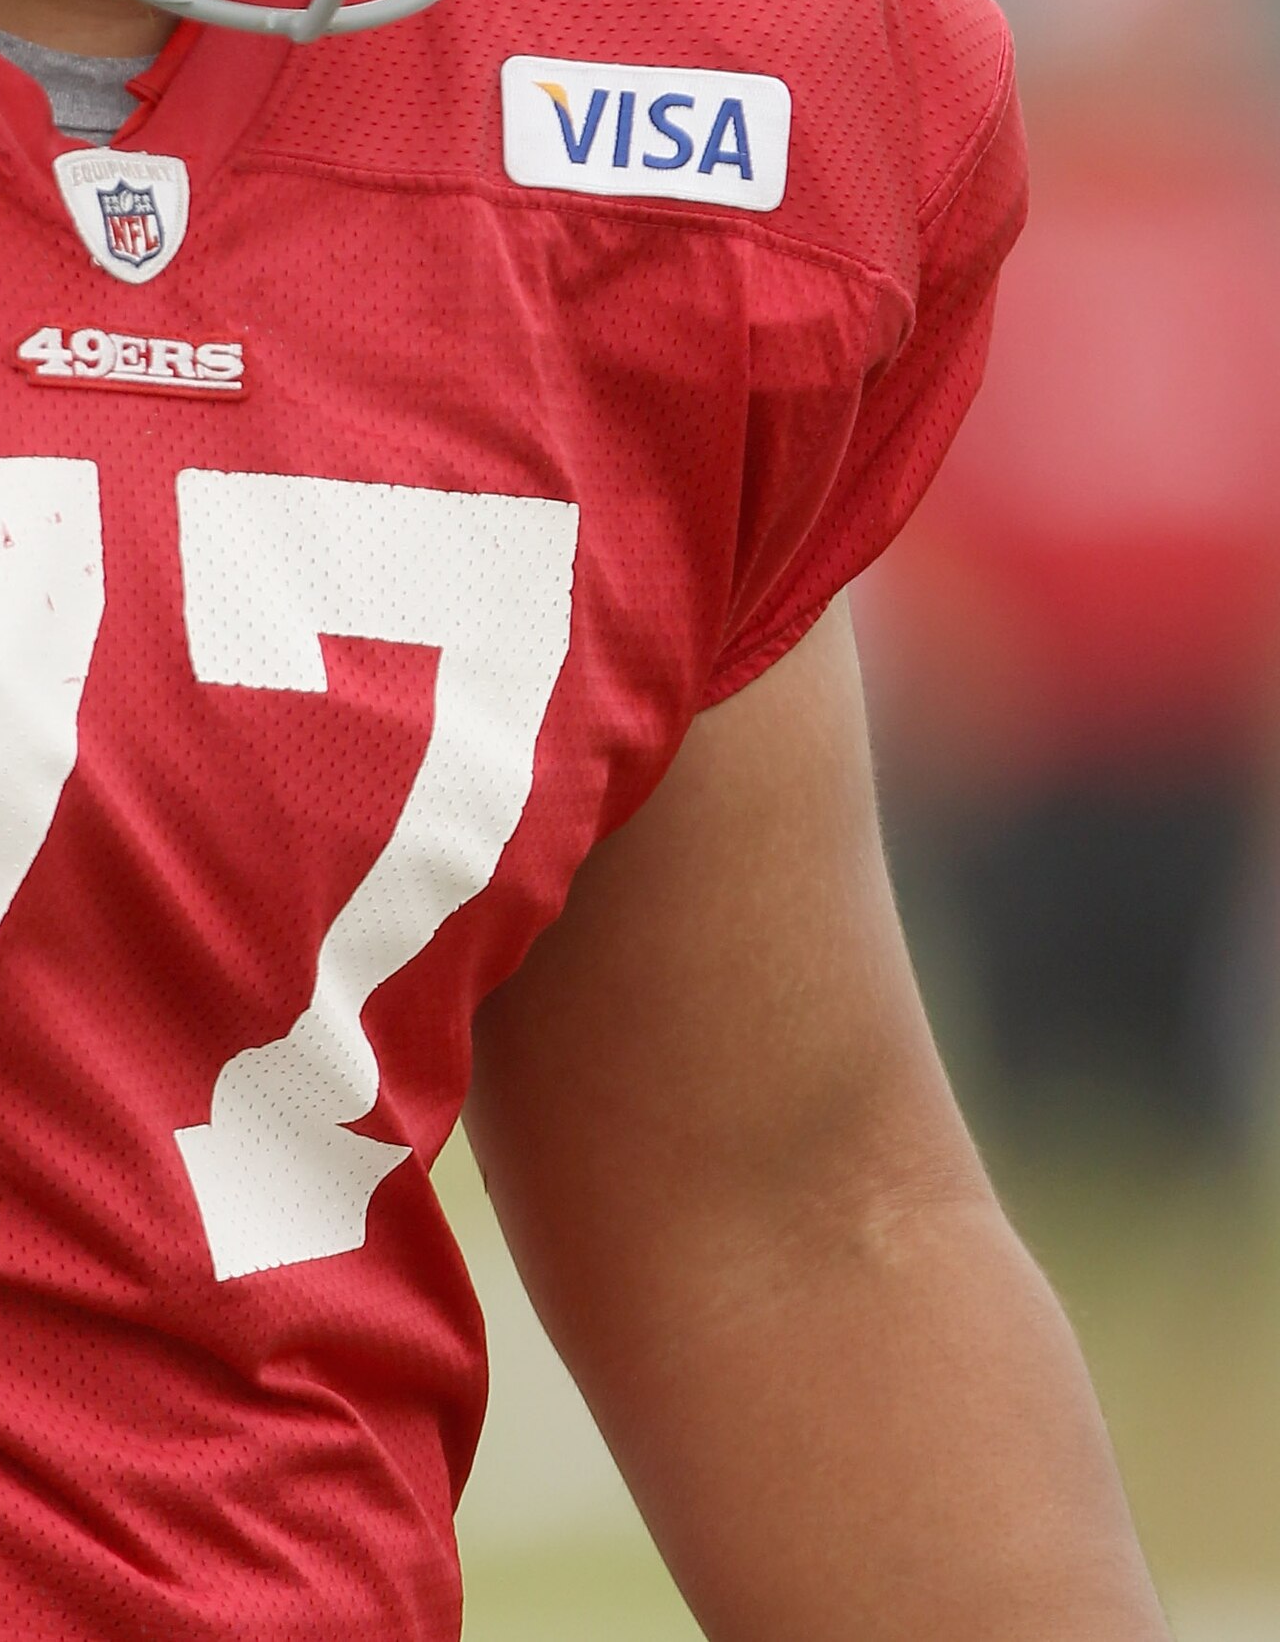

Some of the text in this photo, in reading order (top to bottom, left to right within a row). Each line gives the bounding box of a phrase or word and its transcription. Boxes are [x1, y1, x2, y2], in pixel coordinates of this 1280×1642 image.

[532, 81, 753, 181] VISA
[107, 214, 160, 254] NFL
[17, 326, 244, 381] 49ERS
